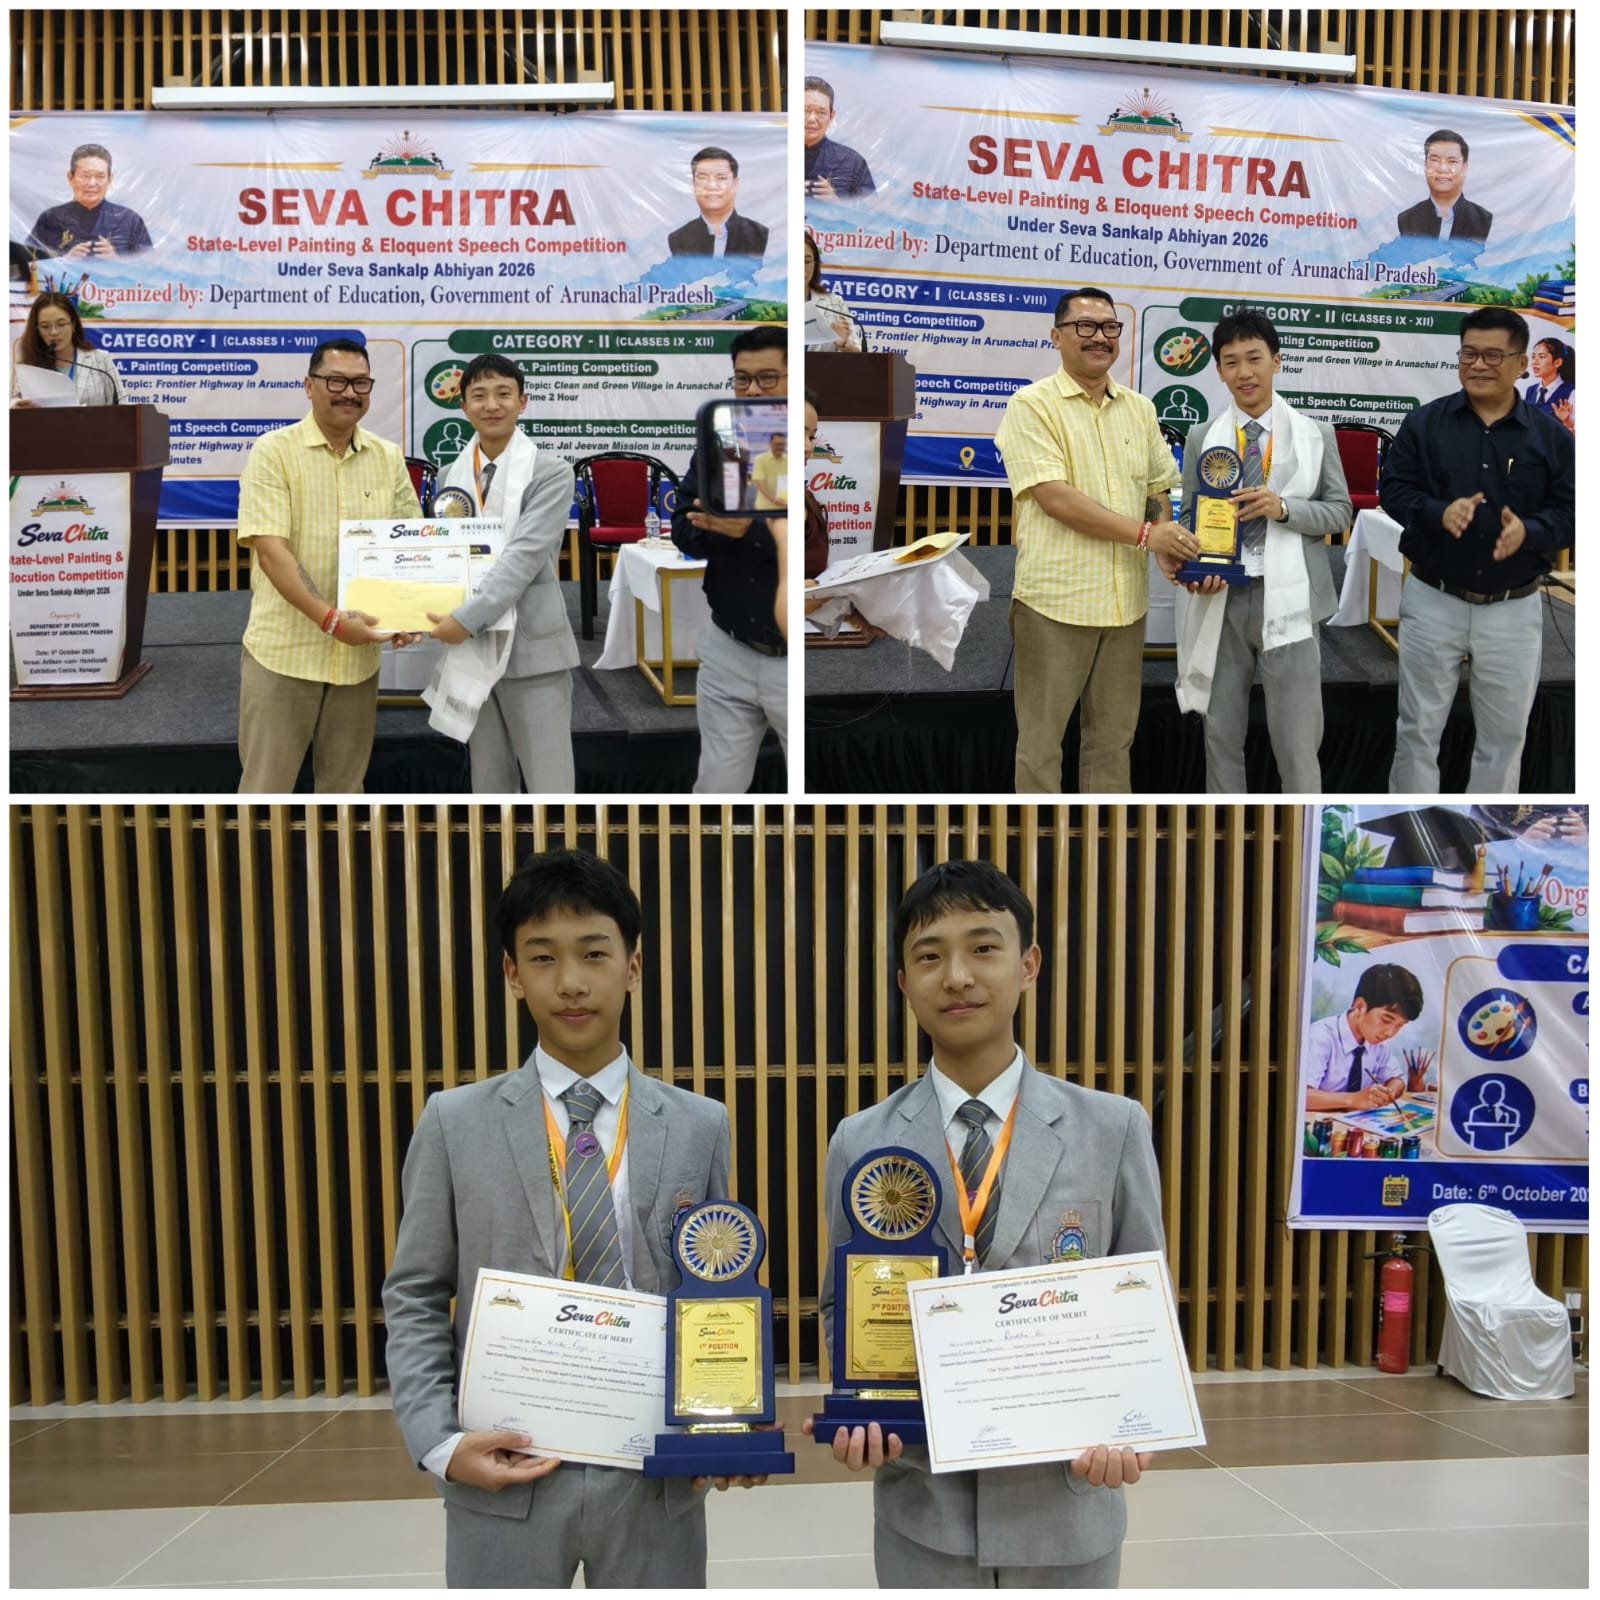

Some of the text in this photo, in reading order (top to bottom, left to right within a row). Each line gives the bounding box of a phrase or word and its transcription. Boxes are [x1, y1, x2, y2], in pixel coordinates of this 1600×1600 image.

[967, 134, 1311, 199] SEVA CHITRA
[238, 187, 576, 227] SEVA CHITRA
[912, 182, 1358, 231] State-Level Painting & Eloquent Speech Competition
[1008, 216, 1269, 248] Under Seva Sankalp Abhiyan 2026
[187, 236, 627, 257] State-Level Painting & Eloquent Speech Competition
[902, 229, 929, 259] by:
[935, 233, 1040, 262] Department
[1044, 242, 1064, 261] of
[1069, 244, 1158, 271] Education,
[1163, 250, 1263, 275] Government
[1267, 257, 1286, 276] of
[1291, 260, 1370, 281] Arunachal
[1374, 262, 1438, 286] Pradesh
[278, 262, 536, 281] Under Seva Sankalp Abhiyan 2026
[81, 284, 715, 309] Organized by: Department of Education, Government of Arunachal Pradesh
[935, 287, 941, 300] I
[948, 289, 1006, 304] (CLASSES
[1023, 294, 1048, 306] VIII)
[903, 313, 978, 330] Competition
[1325, 309, 1434, 328] II (CLASSES IX XII)
[100, 334, 318, 348] CATEGORY I (CLASSES VIII)
[492, 334, 715, 349] CATEGORY II (CLASSES IX XII)
[875, 331, 919, 342] Frontier
[922, 333, 969, 347] Highway
[971, 336, 982, 345] in
[984, 337, 1039, 349] Arunachal
[1308, 336, 1374, 349] Competition
[131, 361, 252, 374] Painting Competition
[1281, 353, 1439, 369] Clean and Green Village in Arunachal
[532, 362, 652, 376] Painting Competition
[1282, 366, 1303, 374] Hour
[121, 379, 153, 390] Topic:
[155, 379, 197, 389] Frontier
[200, 379, 243, 391] Highway
[246, 379, 256, 388] in
[525, 381, 551, 391] Topic:
[554, 381, 580, 390] Clean
[582, 381, 599, 390] and
[602, 381, 628, 390] Green
[631, 381, 663, 391] Village
[666, 382, 674, 391] in
[676, 381, 724, 391] Arunachal
[916, 379, 950, 391] peech
[152, 395, 187, 403] 2 Hour
[549, 393, 555, 401] 2
[557, 393, 578, 401] Hour
[920, 396, 967, 410] Highway
[970, 399, 979, 408] in
[1307, 397, 1347, 410] Speech
[1349, 398, 1414, 411] Competition
[1331, 414, 1366, 424] Mission
[1368, 416, 1377, 424] in
[185, 422, 228, 435] Speech
[532, 424, 582, 435] Eloquent
[585, 424, 627, 436] Speech
[199, 441, 243, 453] Highway
[557, 442, 660, 451] Jal Jeevan Mission in
[864, 501, 872, 511] &
[67, 551, 112, 565] Painting
[115, 551, 123, 562] &
[58, 570, 124, 584] Competition
[1432, 1183, 1473, 1200] Date:
[1502, 1185, 1566, 1202] October
[882, 1303, 910, 1311] POSITIO
[995, 1315, 1047, 1328] CERTIFICATE
[1061, 1310, 1088, 1320] MERIT
[548, 1326, 634, 1344] CERTIFICATE OF MERIT
